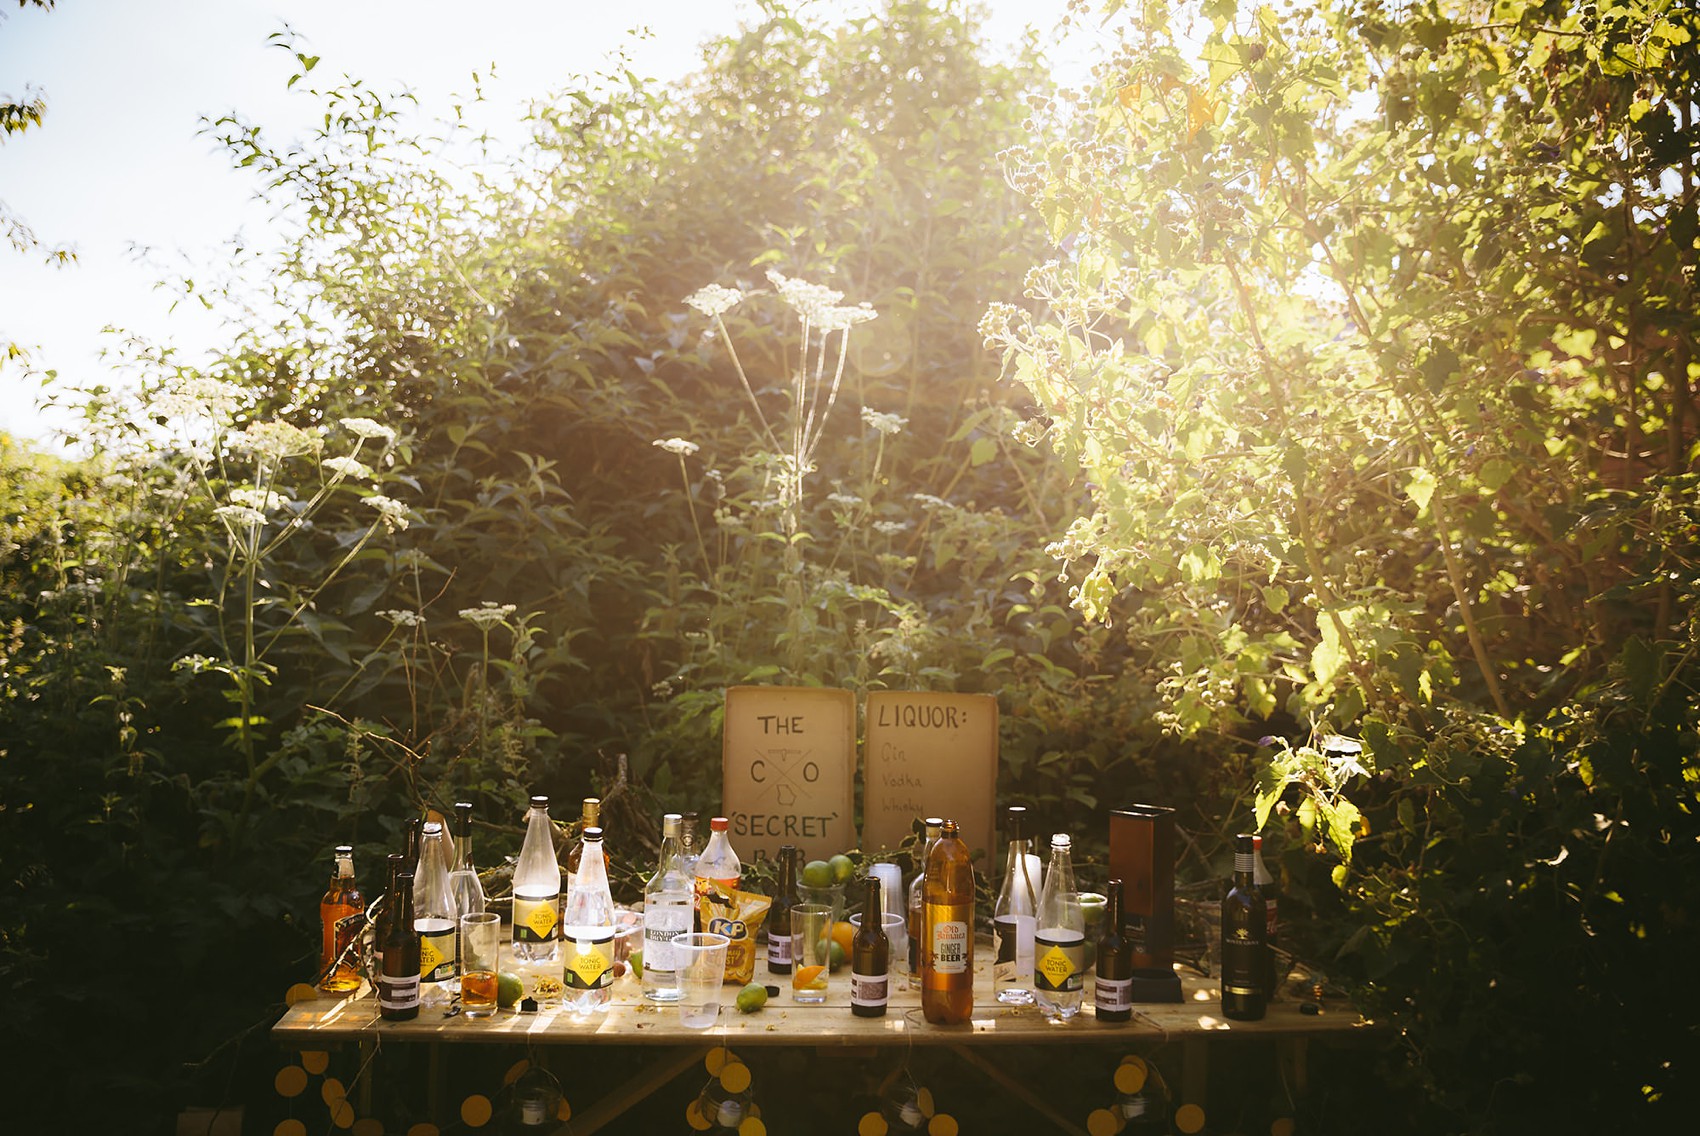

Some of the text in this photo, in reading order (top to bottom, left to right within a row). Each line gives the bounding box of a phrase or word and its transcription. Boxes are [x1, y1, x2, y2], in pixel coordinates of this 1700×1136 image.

[878, 704, 967, 729] LIQUOR:
[757, 715, 804, 735] THE
[751, 760, 766, 783] C
[882, 773, 922, 788] Vodka
[650, 929, 679, 938] LONDON
[713, 920, 744, 937] KP
[940, 954, 961, 962] BEER
[1046, 959, 1066, 967] TONIC
